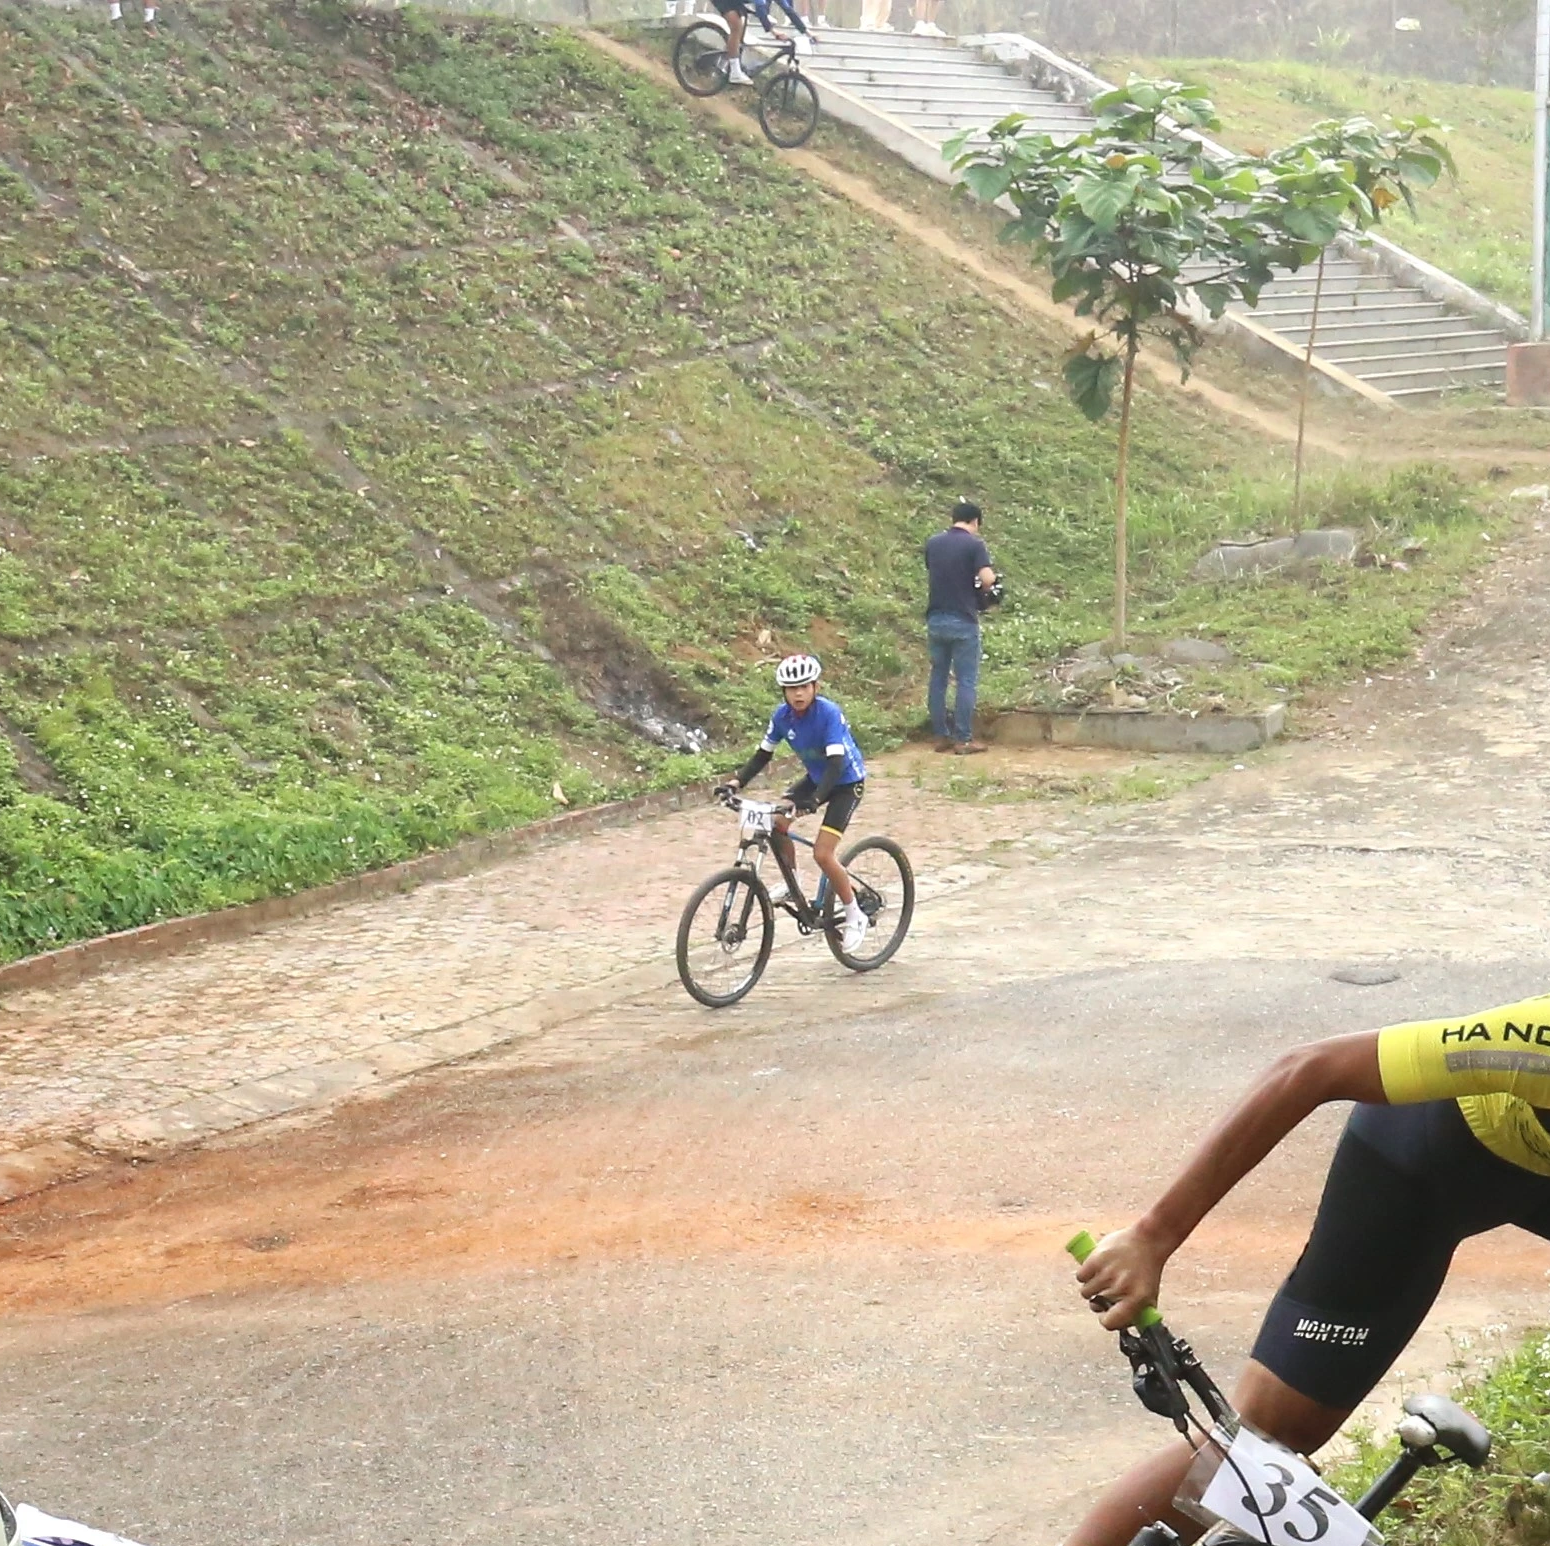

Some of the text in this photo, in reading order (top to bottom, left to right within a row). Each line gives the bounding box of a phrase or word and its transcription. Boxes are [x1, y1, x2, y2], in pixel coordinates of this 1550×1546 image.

[747, 809, 764, 826] 02
[1441, 1022, 1492, 1045] HA
[1293, 1318, 1370, 1346] MONTON
[1241, 1462, 1341, 1543] 35
